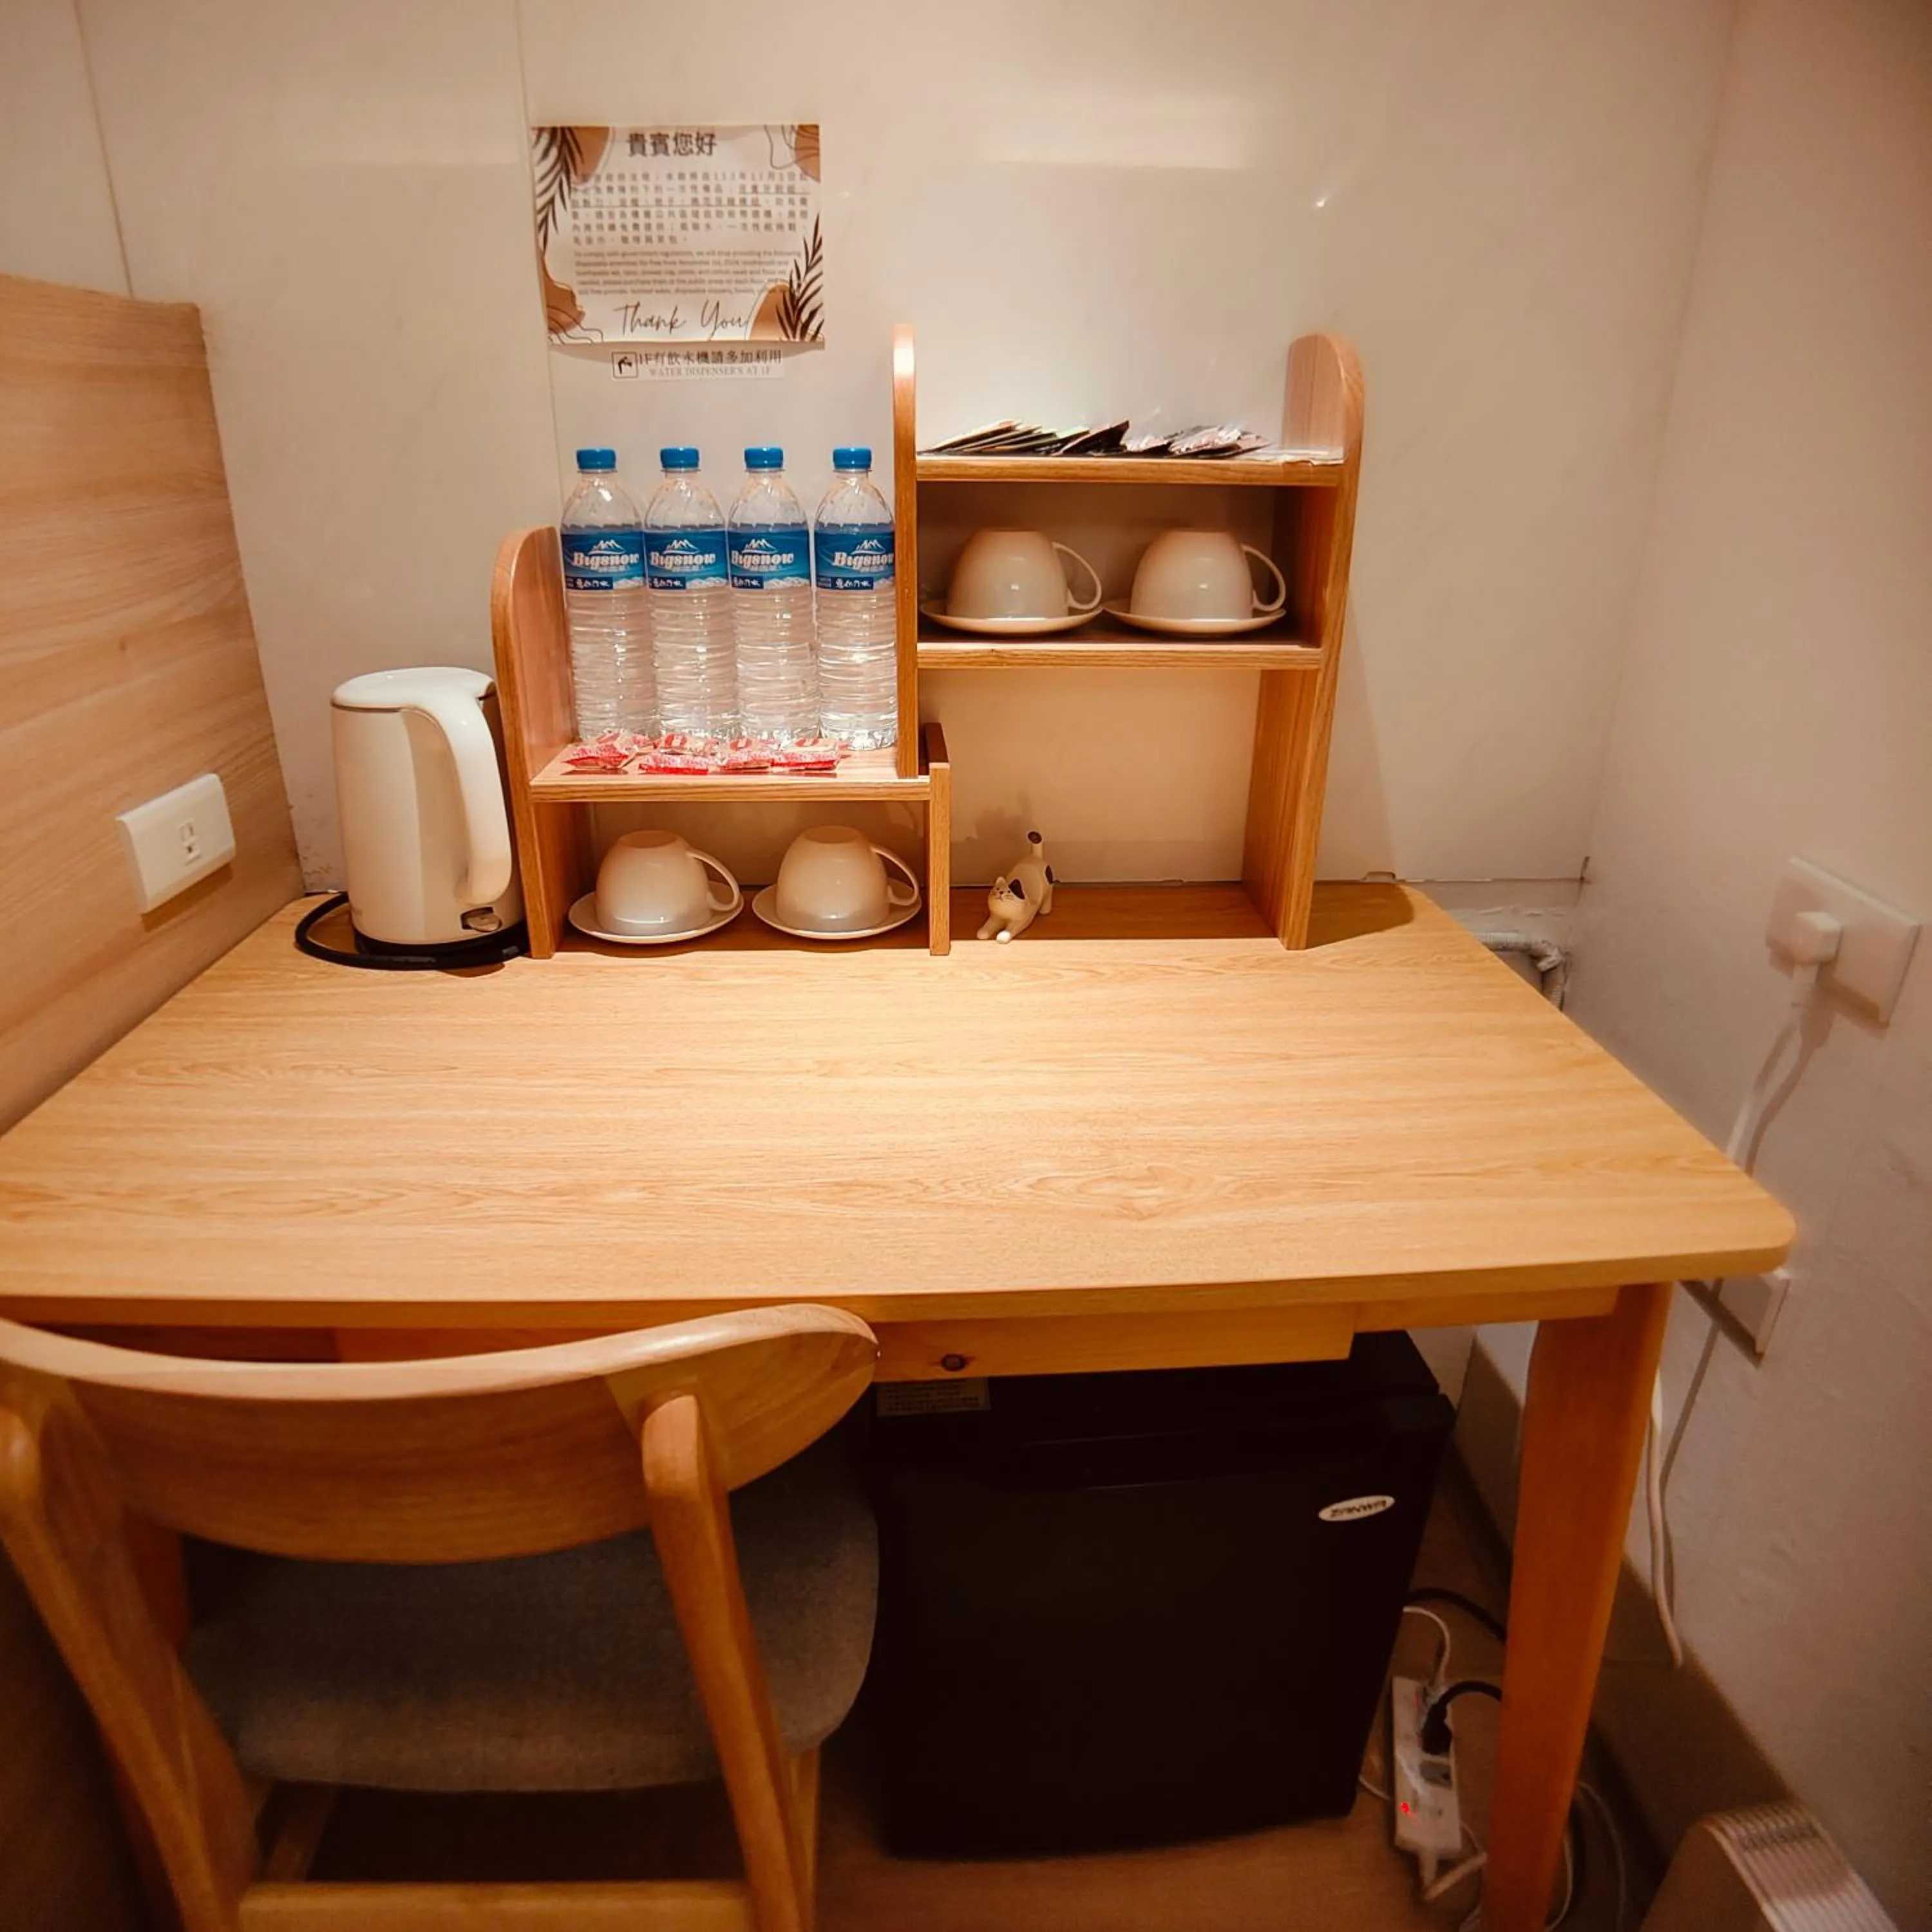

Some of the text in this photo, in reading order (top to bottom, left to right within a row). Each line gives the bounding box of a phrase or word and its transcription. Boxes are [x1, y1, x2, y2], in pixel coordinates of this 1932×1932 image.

[628, 131, 717, 157] 貴賓您好
[614, 300, 687, 336] Thank
